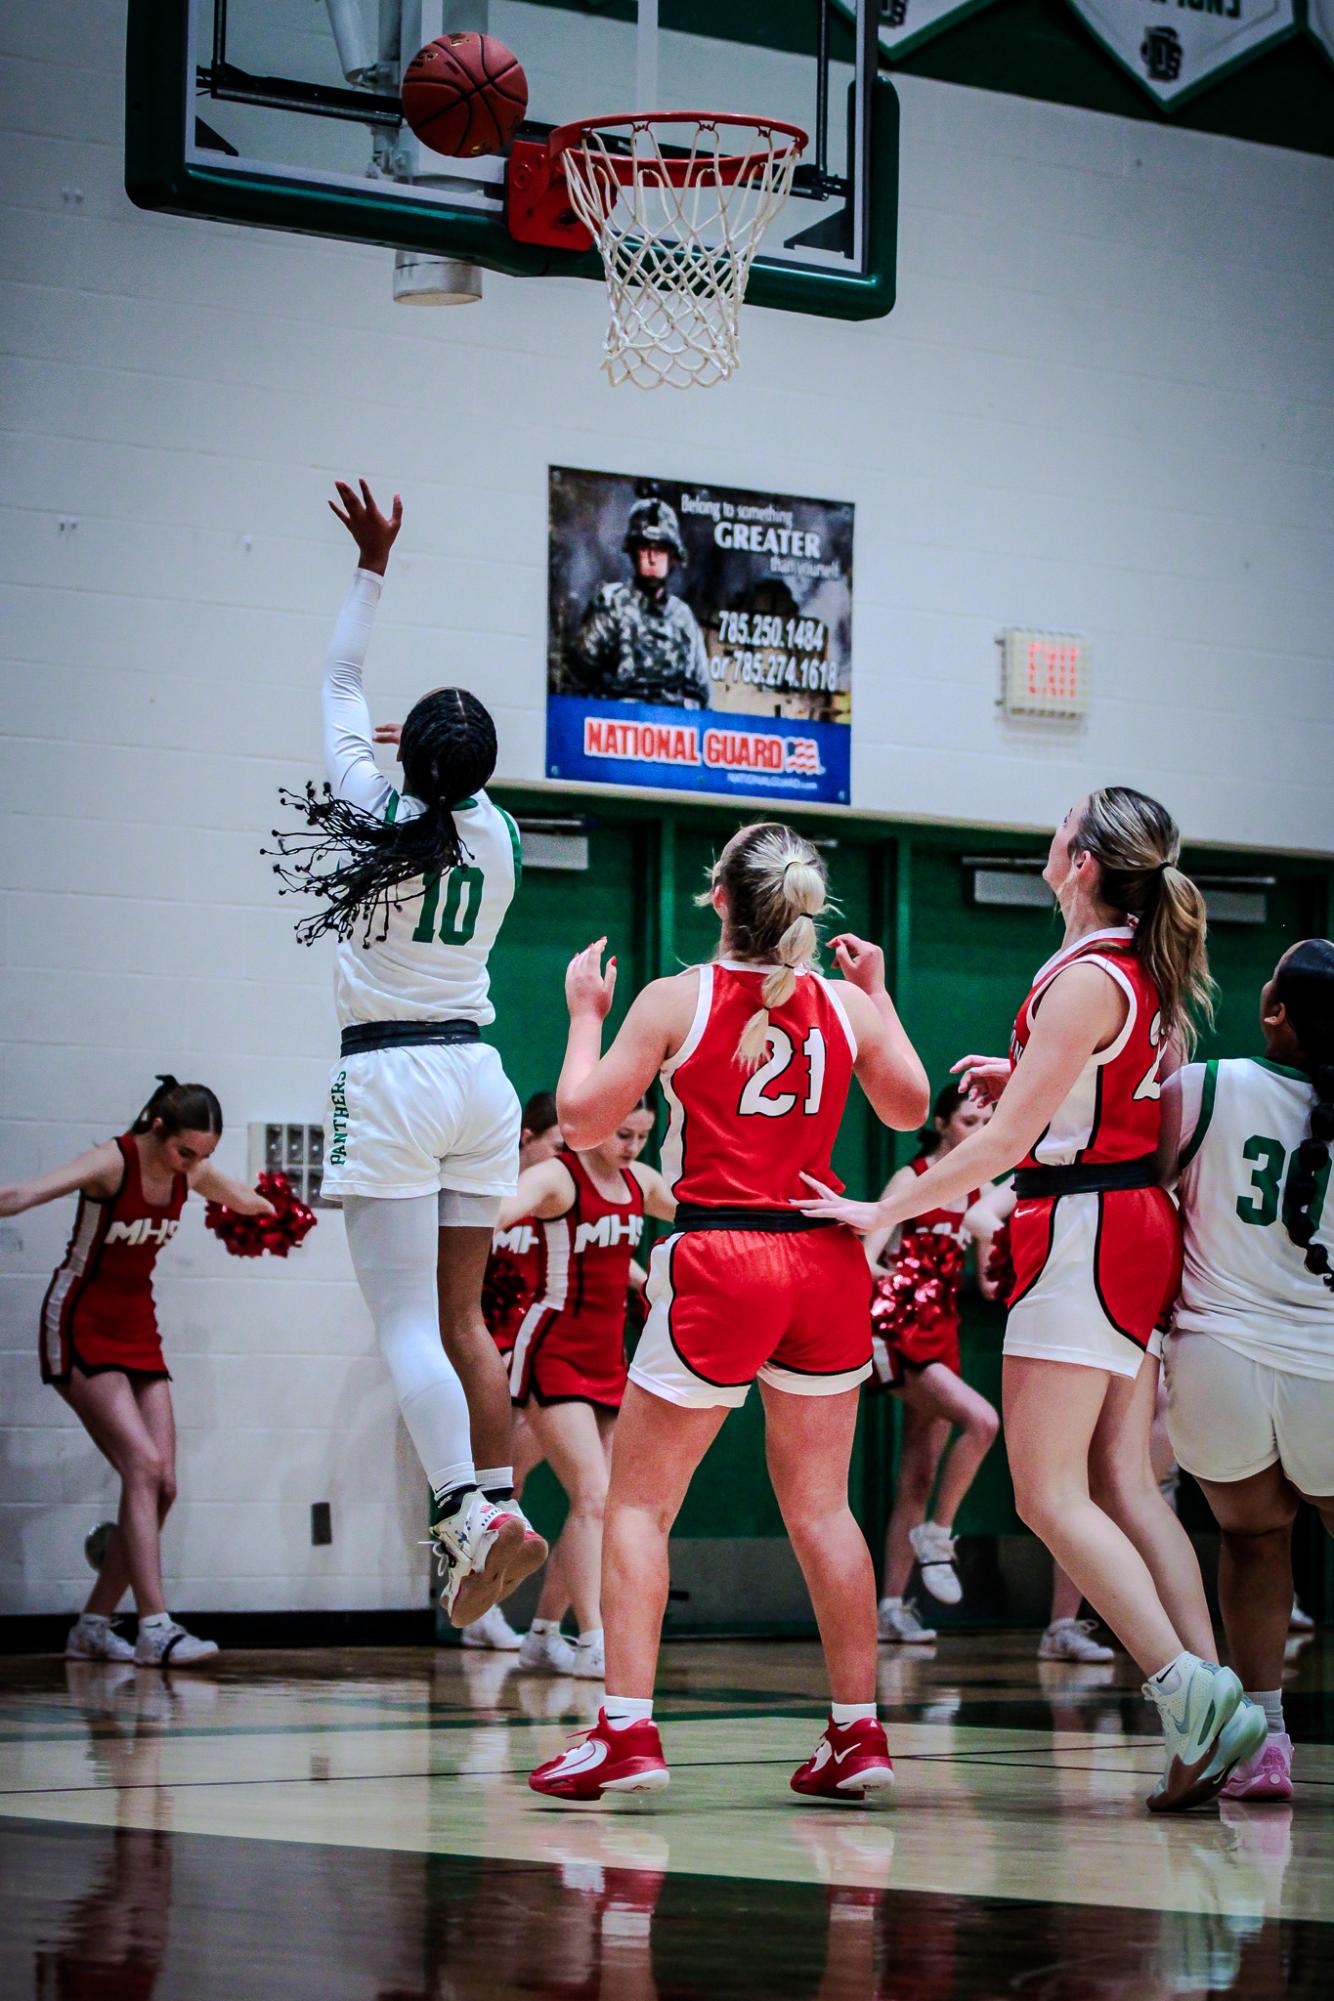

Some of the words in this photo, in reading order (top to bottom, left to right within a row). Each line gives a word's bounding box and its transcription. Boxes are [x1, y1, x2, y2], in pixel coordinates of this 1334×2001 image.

[681, 493, 721, 522] Belong
[723, 502, 735, 518] to
[737, 504, 793, 529] something
[714, 521, 821, 558] GREATER
[770, 556, 795, 573] than
[719, 610, 824, 652] 785.250.1484
[710, 655, 730, 680] or
[733, 650, 838, 692] 785.274.1618
[585, 718, 700, 764] NATIONAL
[704, 730, 784, 771] GUARD
[412, 865, 485, 946] 10
[737, 1024, 826, 1117] 21
[330, 1070, 350, 1166] PANTHERS
